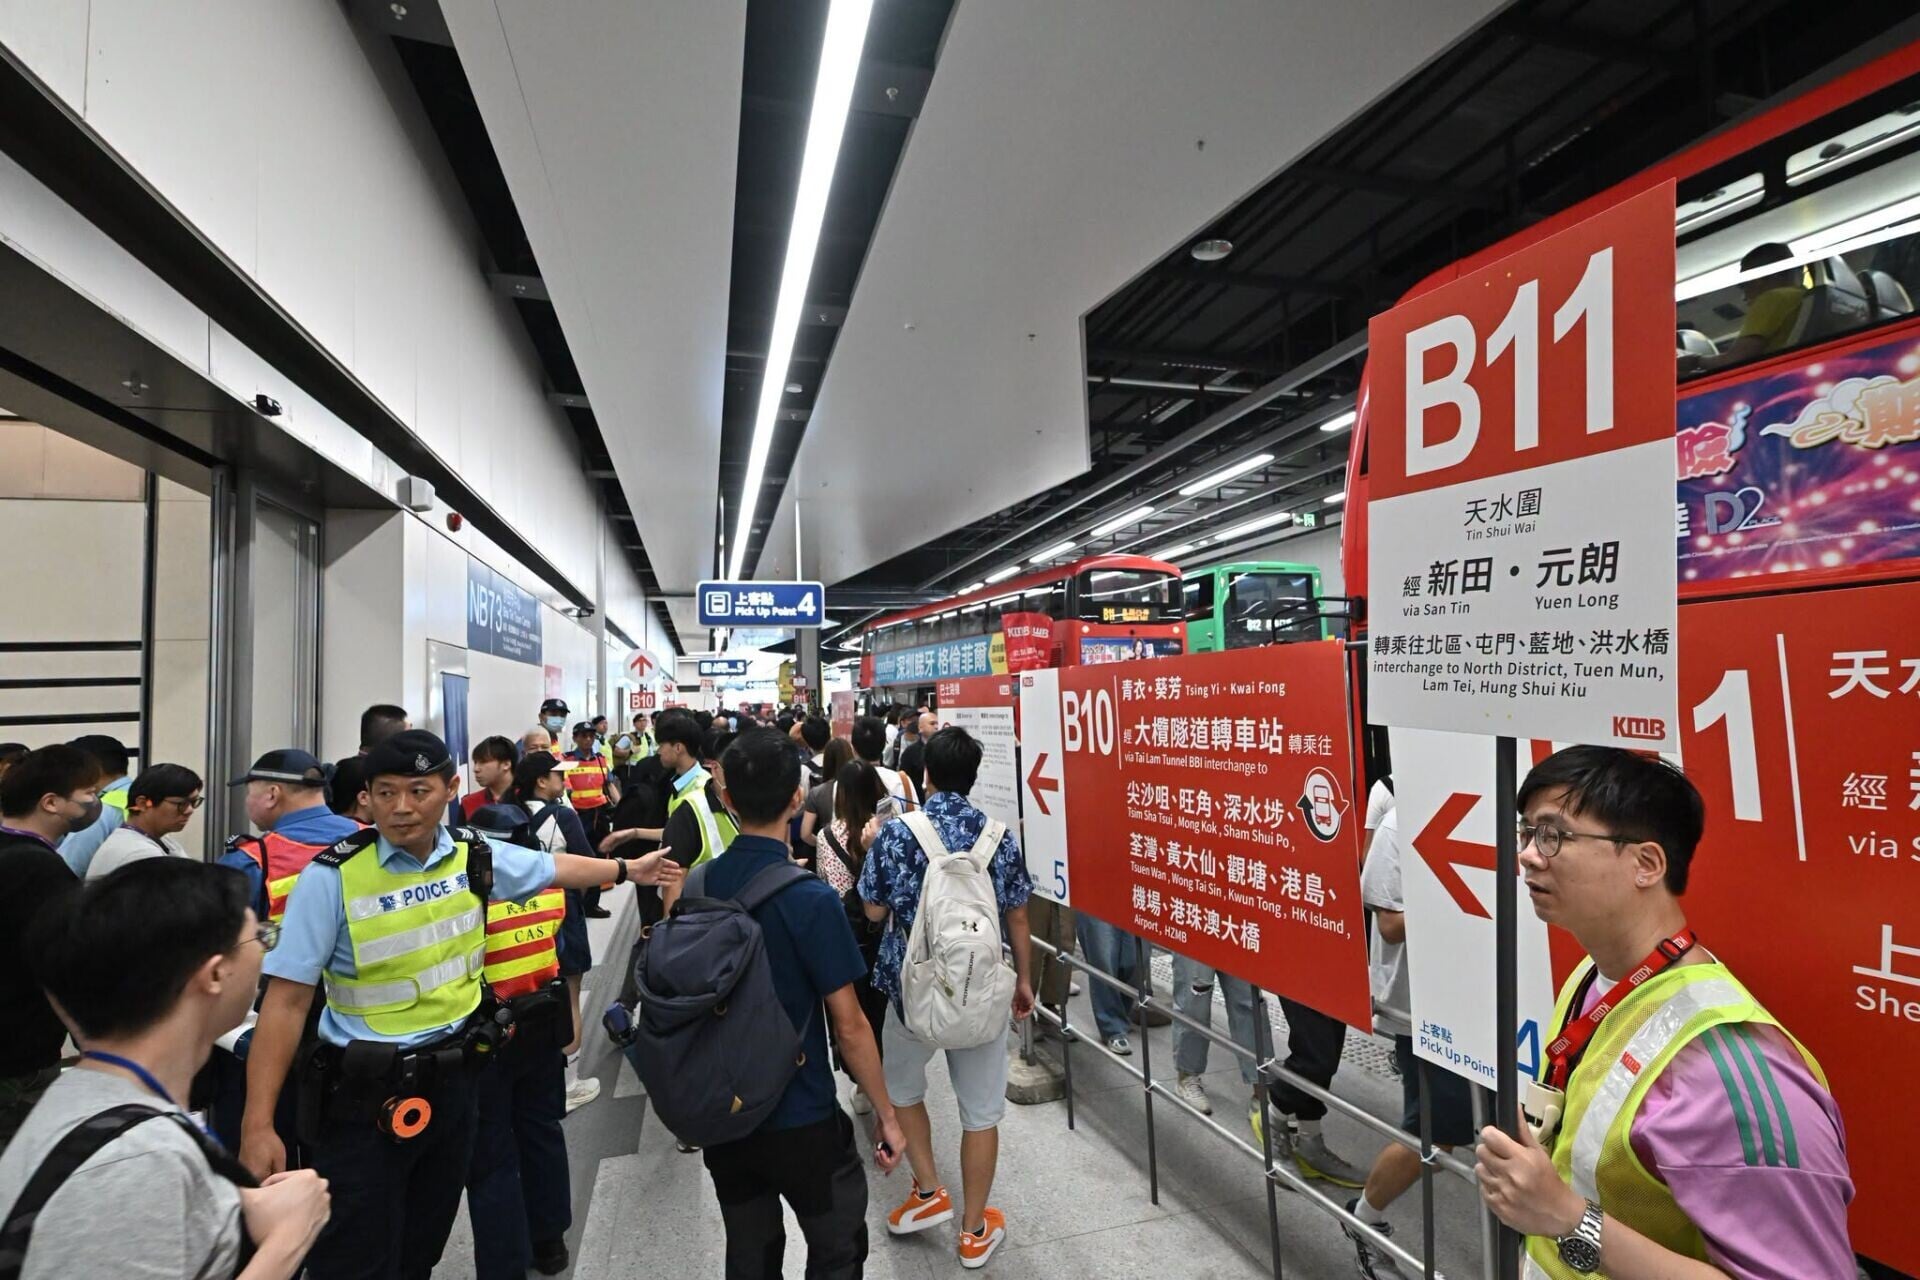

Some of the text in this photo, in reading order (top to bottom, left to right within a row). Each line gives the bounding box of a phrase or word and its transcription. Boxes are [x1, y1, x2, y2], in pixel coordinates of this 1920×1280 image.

[1406, 246, 1613, 477] B11
[1464, 487, 1542, 526] 天水圍
[1466, 520, 1536, 541] Tin Shui Wai
[1402, 575, 1421, 597] 經
[470, 580, 503, 633] NB73
[735, 606, 797, 618] Pick Up Point
[797, 592, 816, 616] 4
[1403, 601, 1470, 617] via San Tin
[1535, 593, 1619, 611] Yuen Long
[1374, 628, 1670, 657] 轉乘往北區、屯門、藍地、洪水橋
[1373, 660, 1664, 682] interchange to North District, Tuen Mun,
[1185, 681, 1286, 698] Tsing Yi Kwai Fong
[1423, 679, 1586, 698] Lam Tei, Hung Shui Kiu
[632, 694, 654, 708] B10
[1062, 689, 1114, 756] B10
[1613, 716, 1666, 740] KMB
[1135, 716, 1283, 754] 大欖隧道轉車站
[1288, 733, 1333, 757] 轉乘往
[1124, 752, 1268, 776] via Tai Lam Tunnel BBI interchange to
[1841, 772, 1888, 811] 經
[1127, 807, 1143, 820] Tsim
[1143, 809, 1157, 821] Sha
[1178, 816, 1200, 834] Mong
[1223, 824, 1250, 841] Sham
[1251, 828, 1274, 845] Shui
[1848, 831, 1898, 859] via
[1054, 860, 1066, 900] 5
[1130, 861, 1150, 876] Tsuen
[1171, 872, 1194, 893] Wong
[1195, 878, 1207, 893] Tai
[1228, 888, 1254, 907] Kwun
[1292, 906, 1308, 923] HK
[402, 880, 451, 906] POICE
[1131, 884, 1261, 954] 機場、港珠澳大橋
[514, 927, 545, 943] CAS
[1164, 922, 1188, 944] HZMB
[1673, 935, 1689, 949] KM
[1629, 965, 1653, 986] KMB
[1589, 1002, 1611, 1023] KMB
[1420, 1020, 1453, 1044] 上客點
[1420, 1036, 1496, 1078] Pick Up Point
